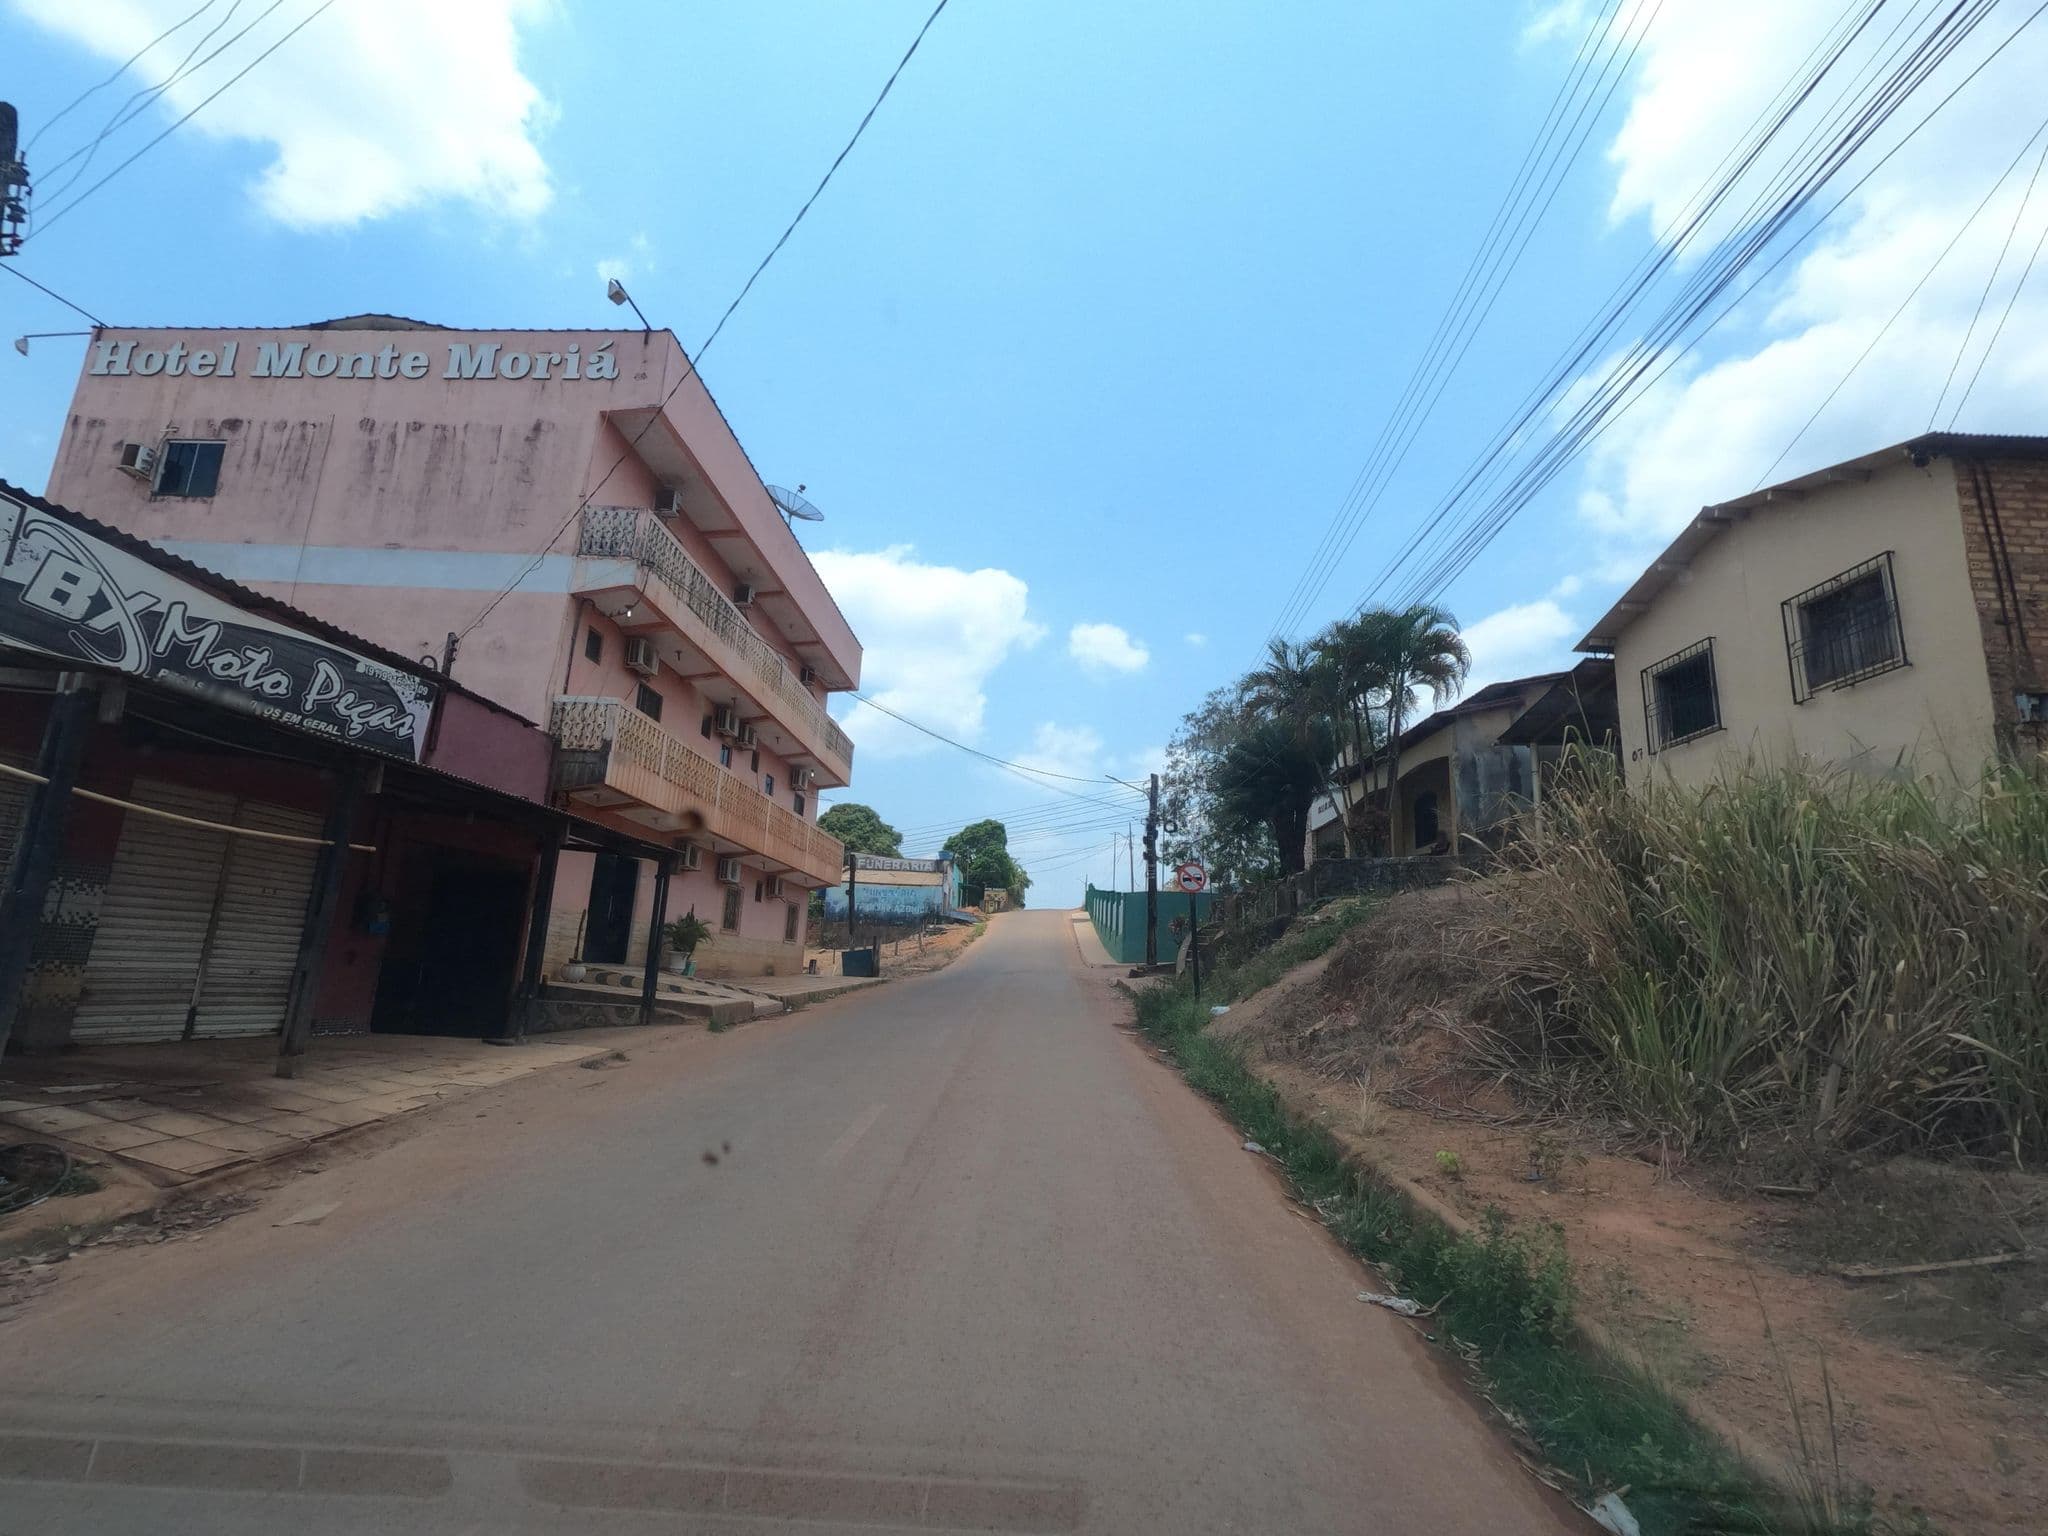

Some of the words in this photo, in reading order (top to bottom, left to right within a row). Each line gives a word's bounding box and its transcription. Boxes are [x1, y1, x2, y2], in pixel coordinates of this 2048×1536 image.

[89, 340, 240, 377] Hotel
[250, 341, 430, 379] Monte
[443, 338, 620, 380] Moriá
[152, 600, 292, 697] Moto
[301, 658, 416, 739] Peças
[282, 710, 303, 725] EM
[302, 717, 342, 736] GERAL
[1631, 747, 1644, 762] 07
